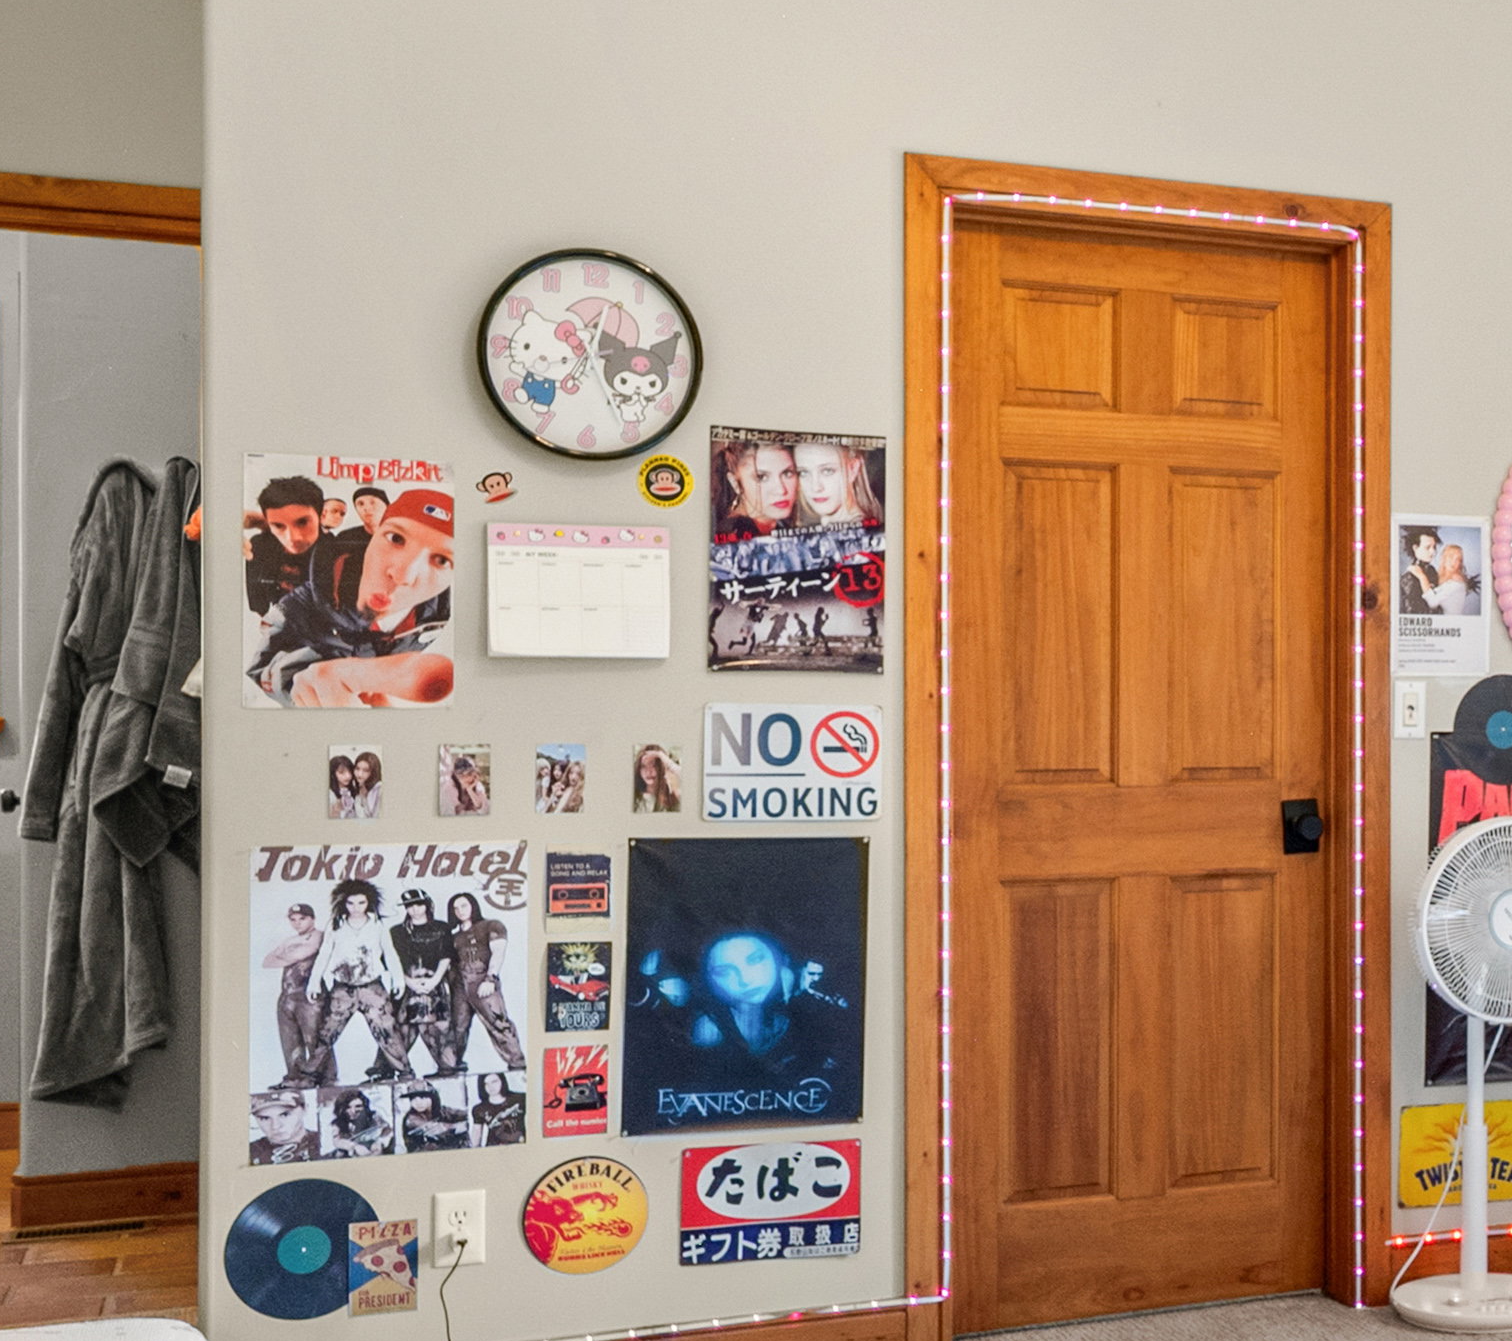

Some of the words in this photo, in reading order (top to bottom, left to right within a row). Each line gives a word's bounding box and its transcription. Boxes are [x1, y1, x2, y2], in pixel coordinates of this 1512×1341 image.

[541, 268, 561, 293] 11
[582, 263, 610, 289] 12
[632, 279, 645, 305] 1
[505, 295, 534, 319] 10
[656, 312, 675, 337] 2
[490, 335, 509, 358] 9
[502, 378, 522, 402] 8
[655, 393, 675, 416] 4
[535, 411, 556, 434] 7
[620, 421, 640, 443] 5
[577, 425, 596, 448] 6
[316, 456, 376, 484] Limp
[377, 458, 444, 483] Bizkit
[719, 572, 841, 605] サーティーン
[841, 564, 882, 592] 13
[1398, 617, 1433, 627] EDWARD
[1398, 627, 1462, 638] SCISSORHANDS
[711, 712, 803, 767] NO
[707, 787, 879, 819] SMOKING
[255, 845, 385, 882] Tokio
[397, 839, 528, 878] Hotel
[657, 1083, 831, 1119] EVANESCENCE
[545, 1162, 634, 1194] FIREBALL
[705, 1151, 843, 1205] たばこ
[358, 1222, 412, 1240] PIZZA
[682, 1227, 782, 1264] ギフト券
[788, 1222, 860, 1246] 取扱店
[358, 1292, 412, 1310] PRESIDENT
